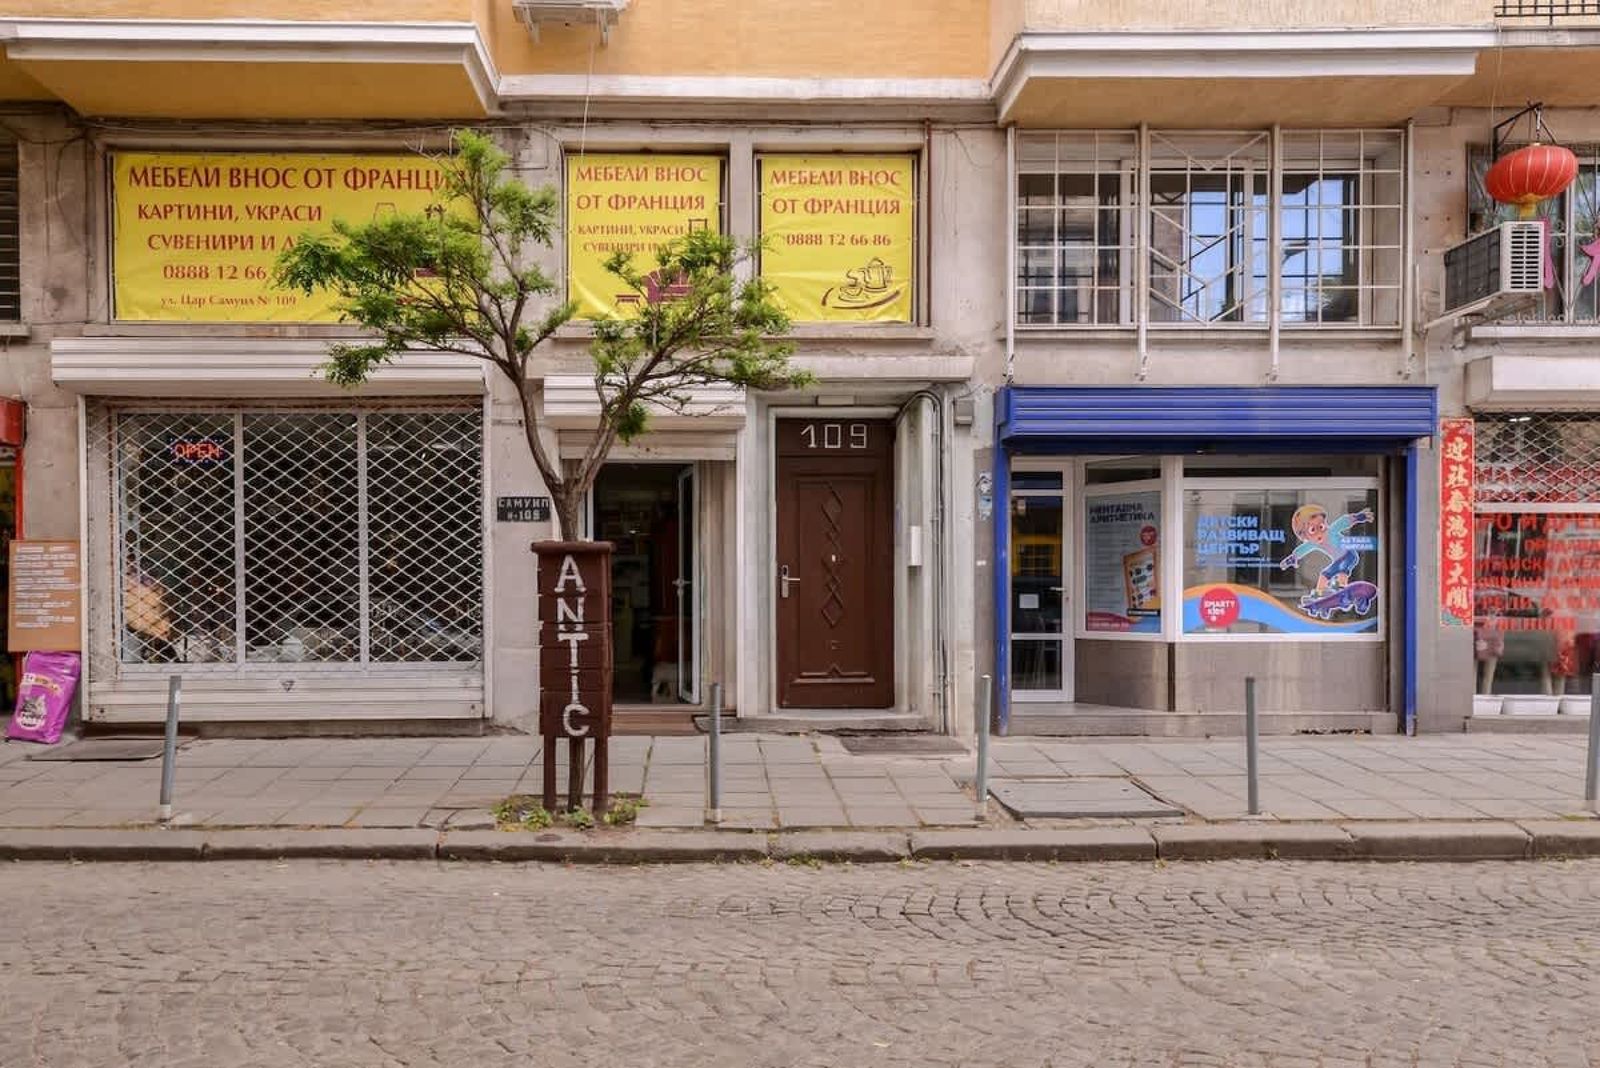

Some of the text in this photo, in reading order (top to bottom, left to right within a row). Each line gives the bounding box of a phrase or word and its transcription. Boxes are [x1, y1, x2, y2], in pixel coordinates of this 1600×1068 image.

[128, 165, 451, 192] МЕБЕЛИ ВНОС ОТ ФРАНЦИ
[576, 166, 709, 182] МЕБЕЛИ ВНОС
[770, 170, 902, 186] МЕБЕЛИ ВНОС
[576, 193, 705, 213] ОТ ФРАНЦИЯ
[772, 197, 900, 217] ОТ ФРАНЦИЯ
[137, 203, 321, 222] КАРТИНИ, УКРАСИ
[640, 224, 684, 236] УКРАСИ
[146, 234, 254, 251] СУВЕНИРИ
[261, 234, 275, 250] И
[583, 241, 645, 253] СУВЕНИРИ
[786, 233, 891, 246] 0888 12 66 86
[163, 265, 209, 280] 0888
[217, 265, 238, 280] 12
[244, 266, 267, 280] 66
[276, 295, 297, 305] 109
[801, 424, 867, 449] 109
[175, 443, 220, 460] OPEN
[554, 554, 590, 736] ANTIC
